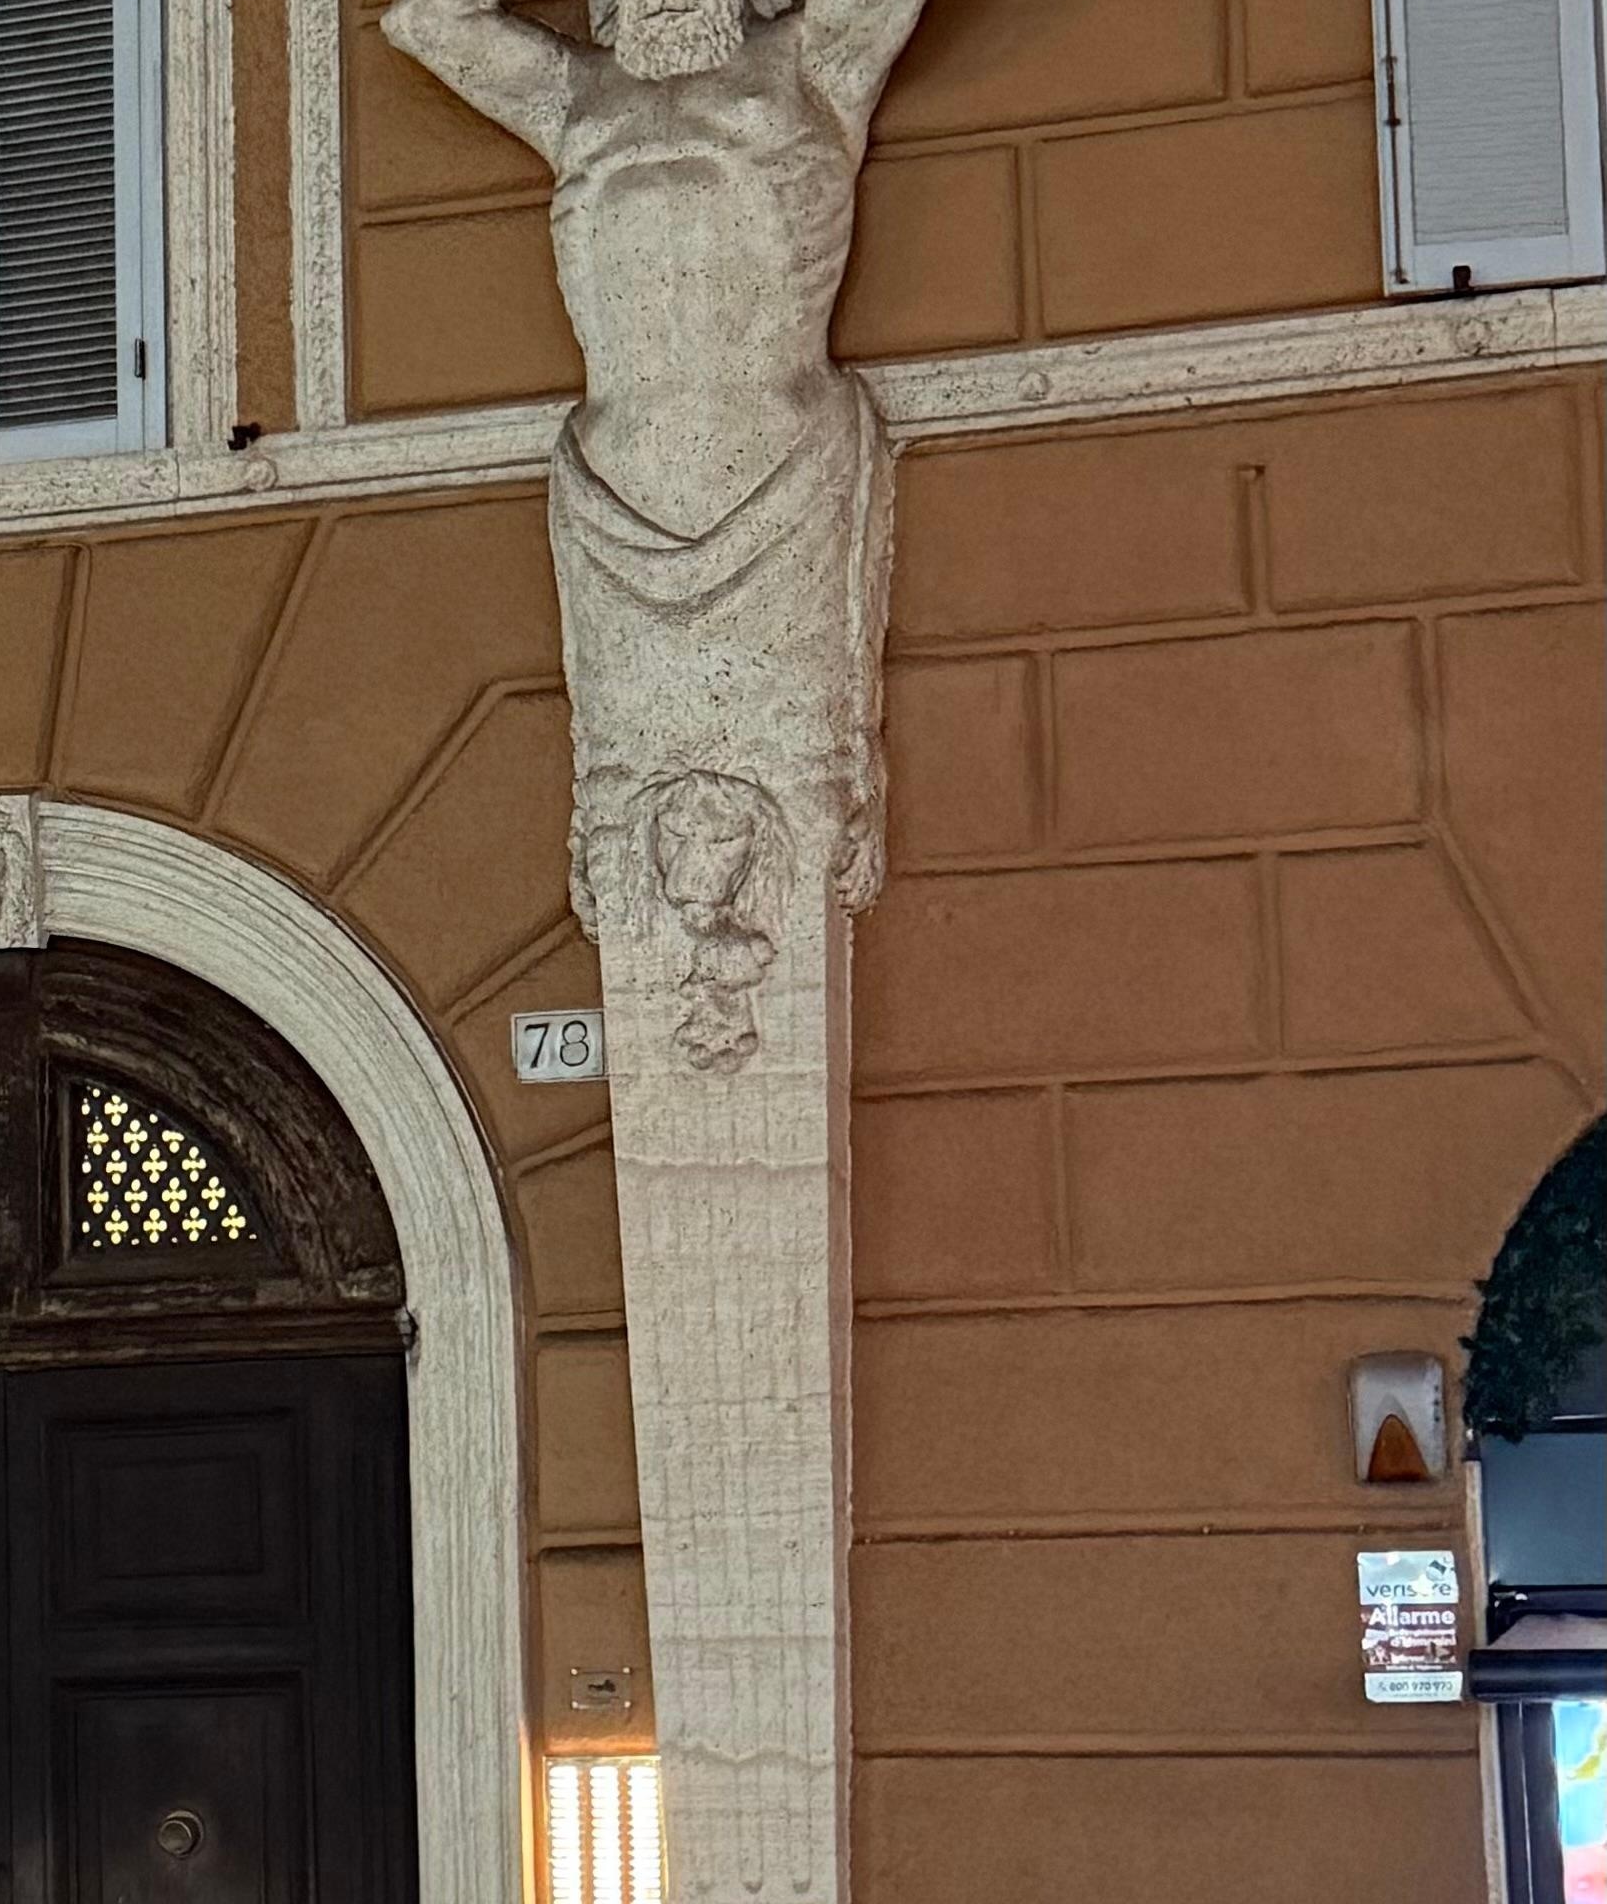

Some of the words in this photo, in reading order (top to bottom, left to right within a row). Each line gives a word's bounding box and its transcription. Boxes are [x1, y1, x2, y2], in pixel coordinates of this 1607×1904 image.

[524, 1020, 589, 1068] 78
[1366, 1583, 1452, 1597] verisre
[1368, 1605, 1456, 1627] Allarme
